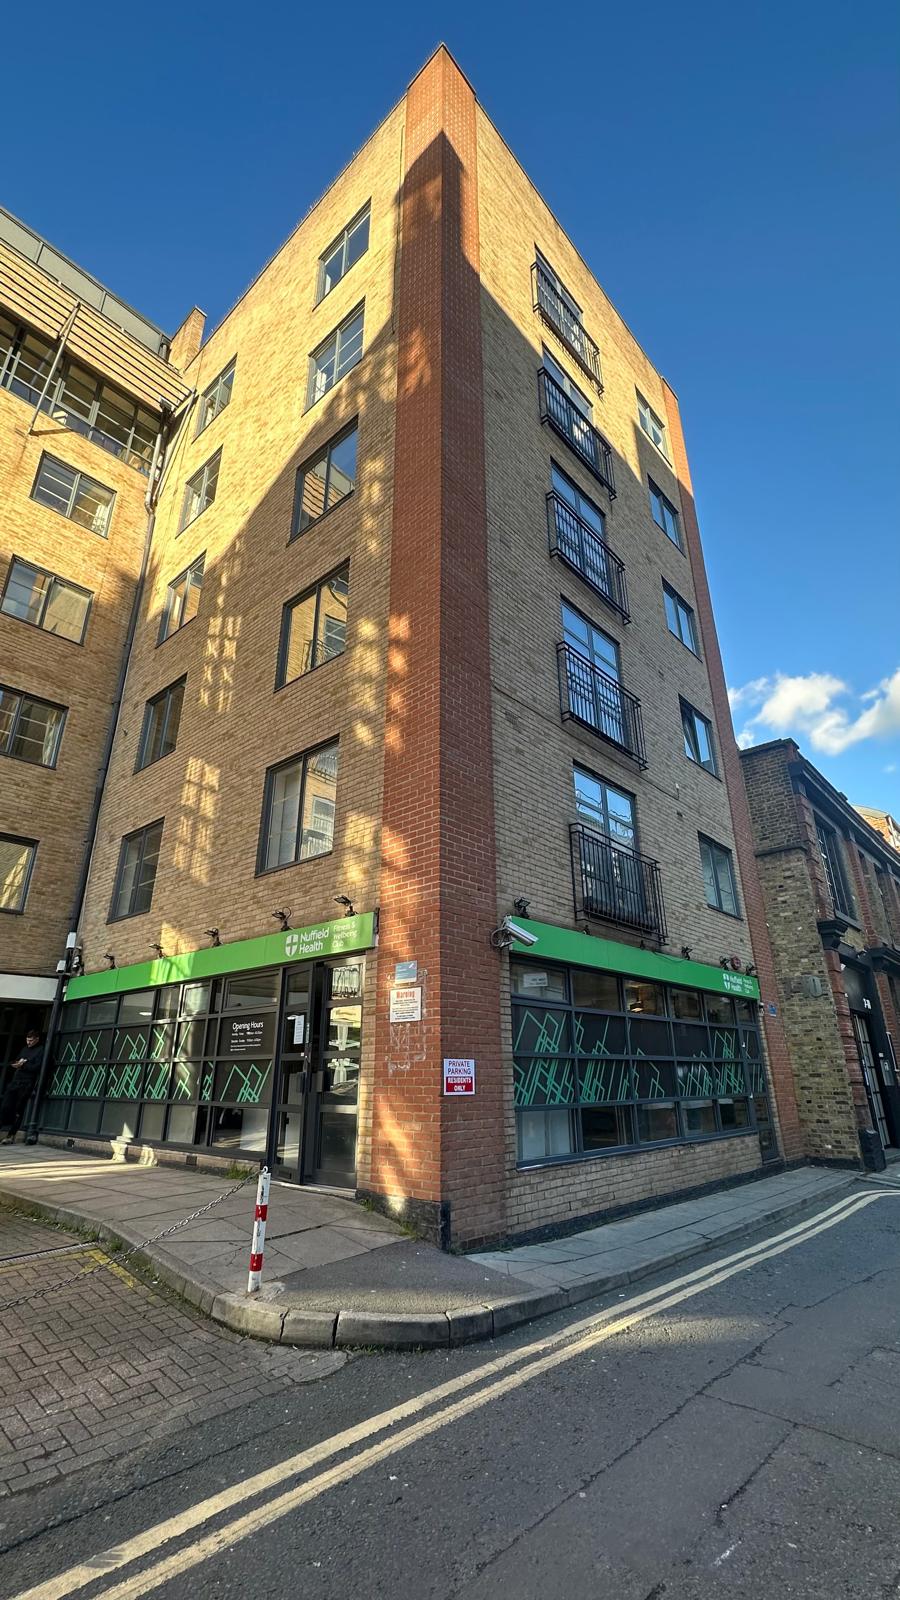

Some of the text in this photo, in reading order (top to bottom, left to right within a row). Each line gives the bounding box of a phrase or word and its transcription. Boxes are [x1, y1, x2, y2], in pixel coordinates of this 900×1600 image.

[300, 927, 330, 942] Nuffield
[299, 940, 323, 954] Health
[232, 1022, 250, 1032] Opening
